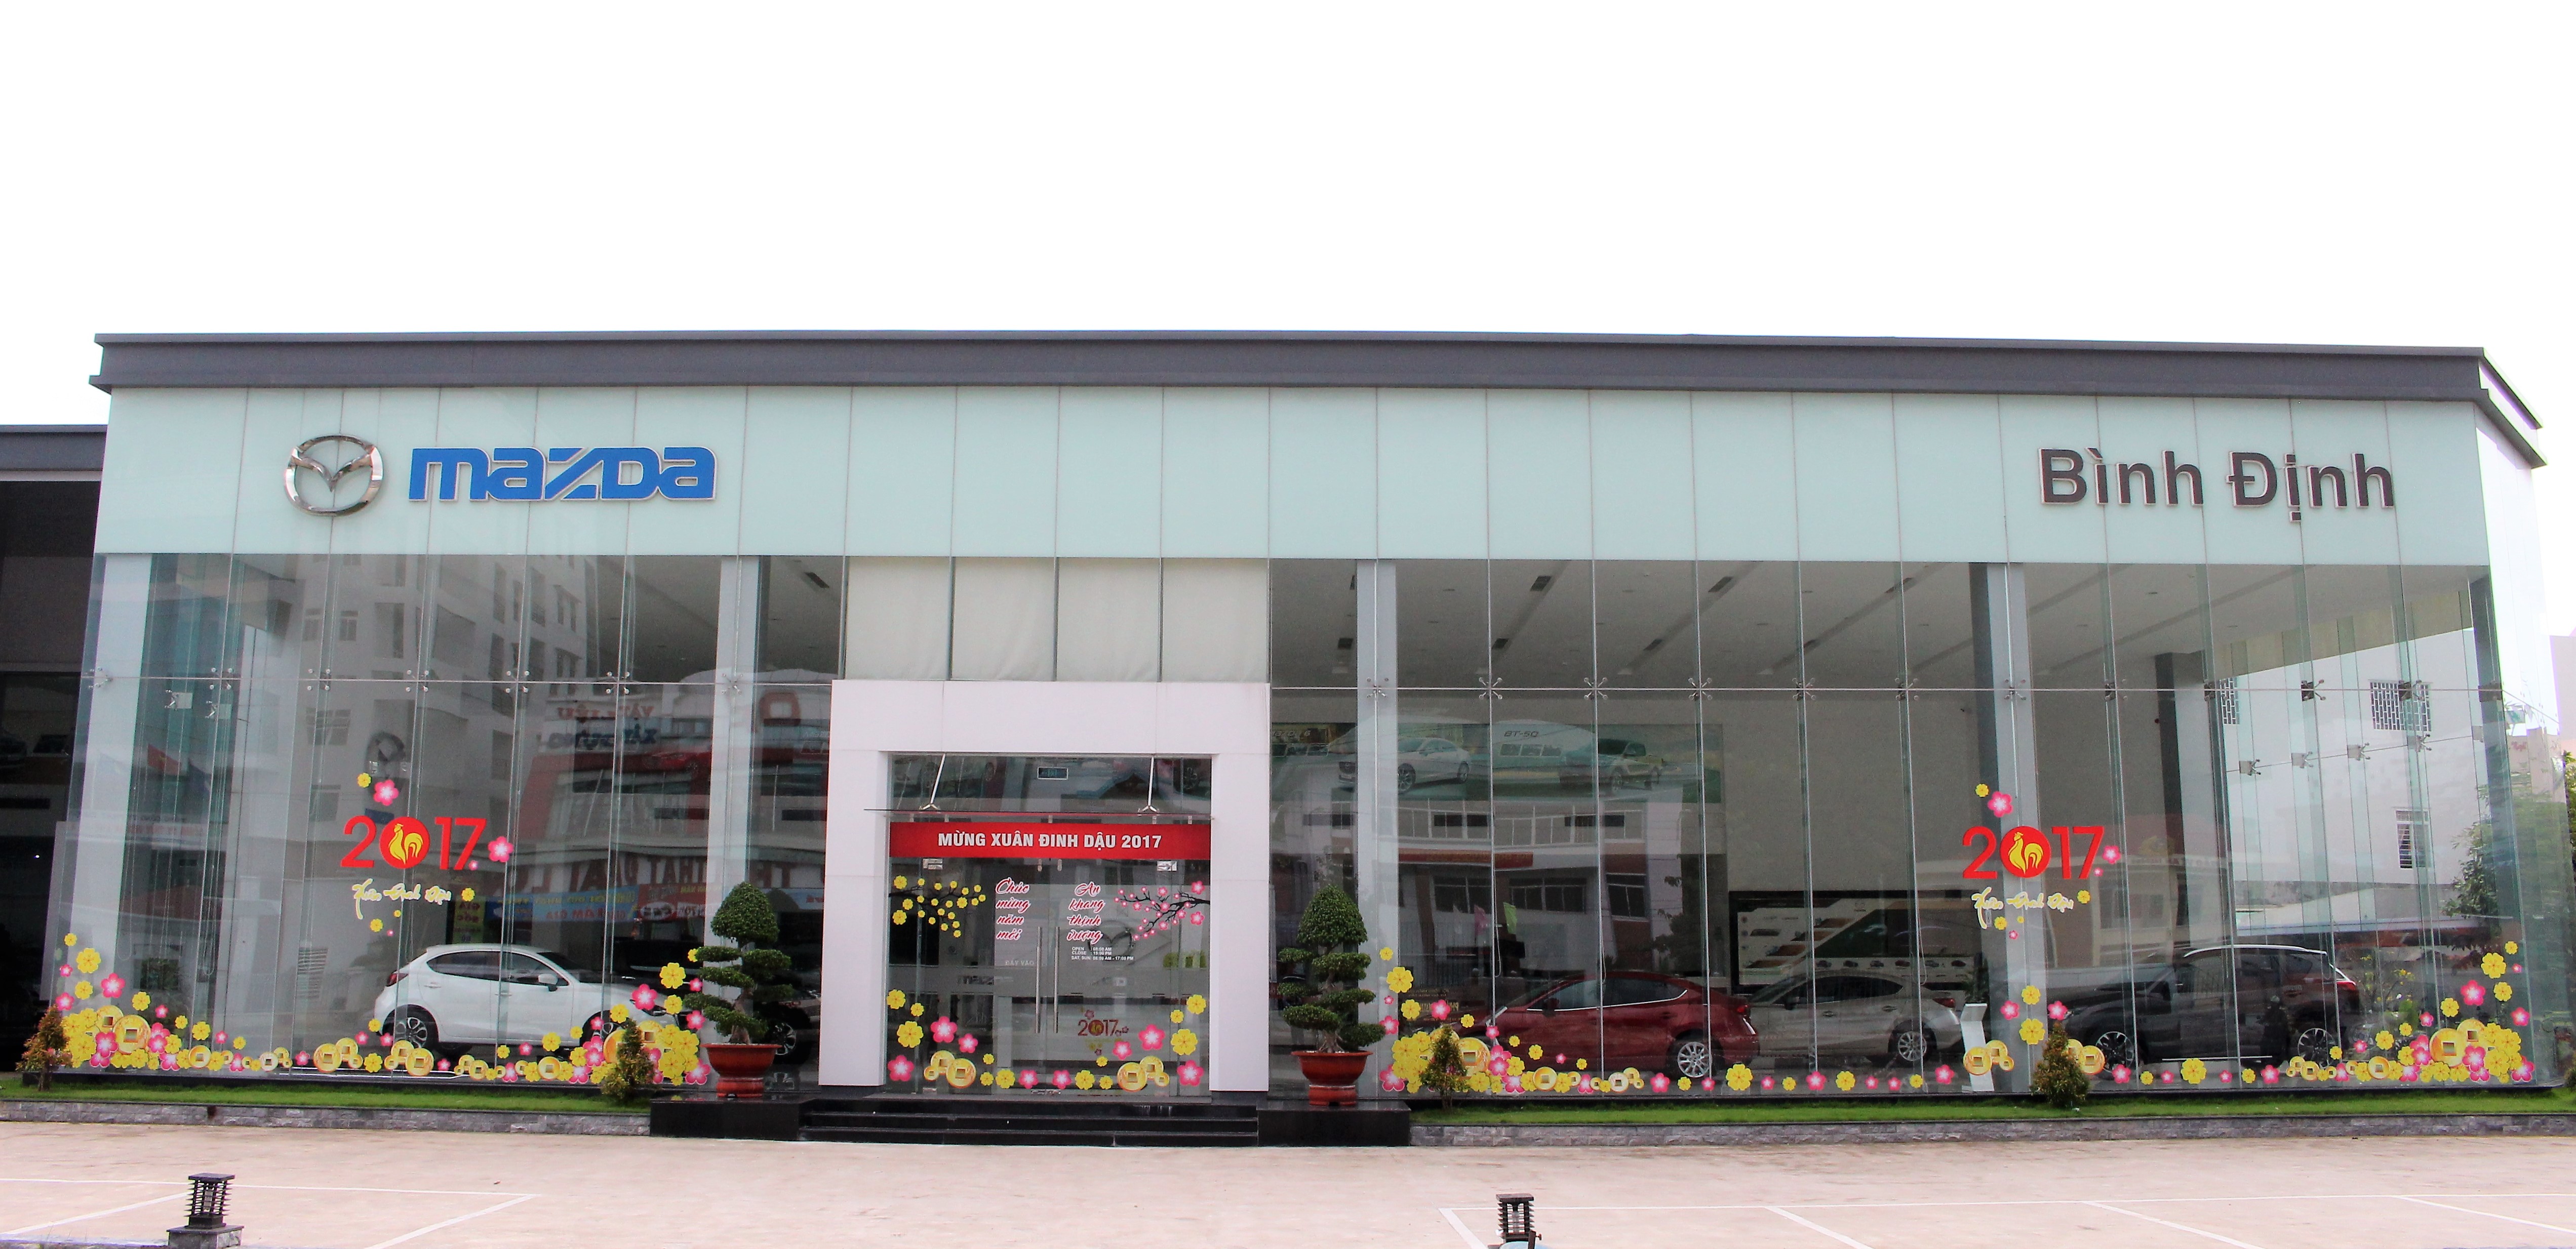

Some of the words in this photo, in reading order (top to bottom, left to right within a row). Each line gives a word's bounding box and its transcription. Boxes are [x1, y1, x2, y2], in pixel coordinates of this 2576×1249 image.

[2038, 448, 2204, 505] Bình
[2226, 451, 2395, 522] Định
[340, 815, 487, 870] 2017
[938, 830, 986, 847] MỪNG
[991, 830, 1033, 847] XUÂN
[1039, 834, 1078, 848] ĐINH
[1084, 832, 1116, 851] DẬU
[1122, 835, 1162, 848] 2017
[1962, 826, 2105, 879] 2017
[995, 877, 1029, 894] Chúc
[1075, 881, 1101, 897] An
[995, 897, 1031, 913] mừng
[1068, 898, 1106, 913] khang
[996, 913, 1024, 925] năm
[1066, 914, 1102, 926] thịnh
[996, 929, 1023, 941] mới
[1078, 1019, 1119, 1036] 2017
